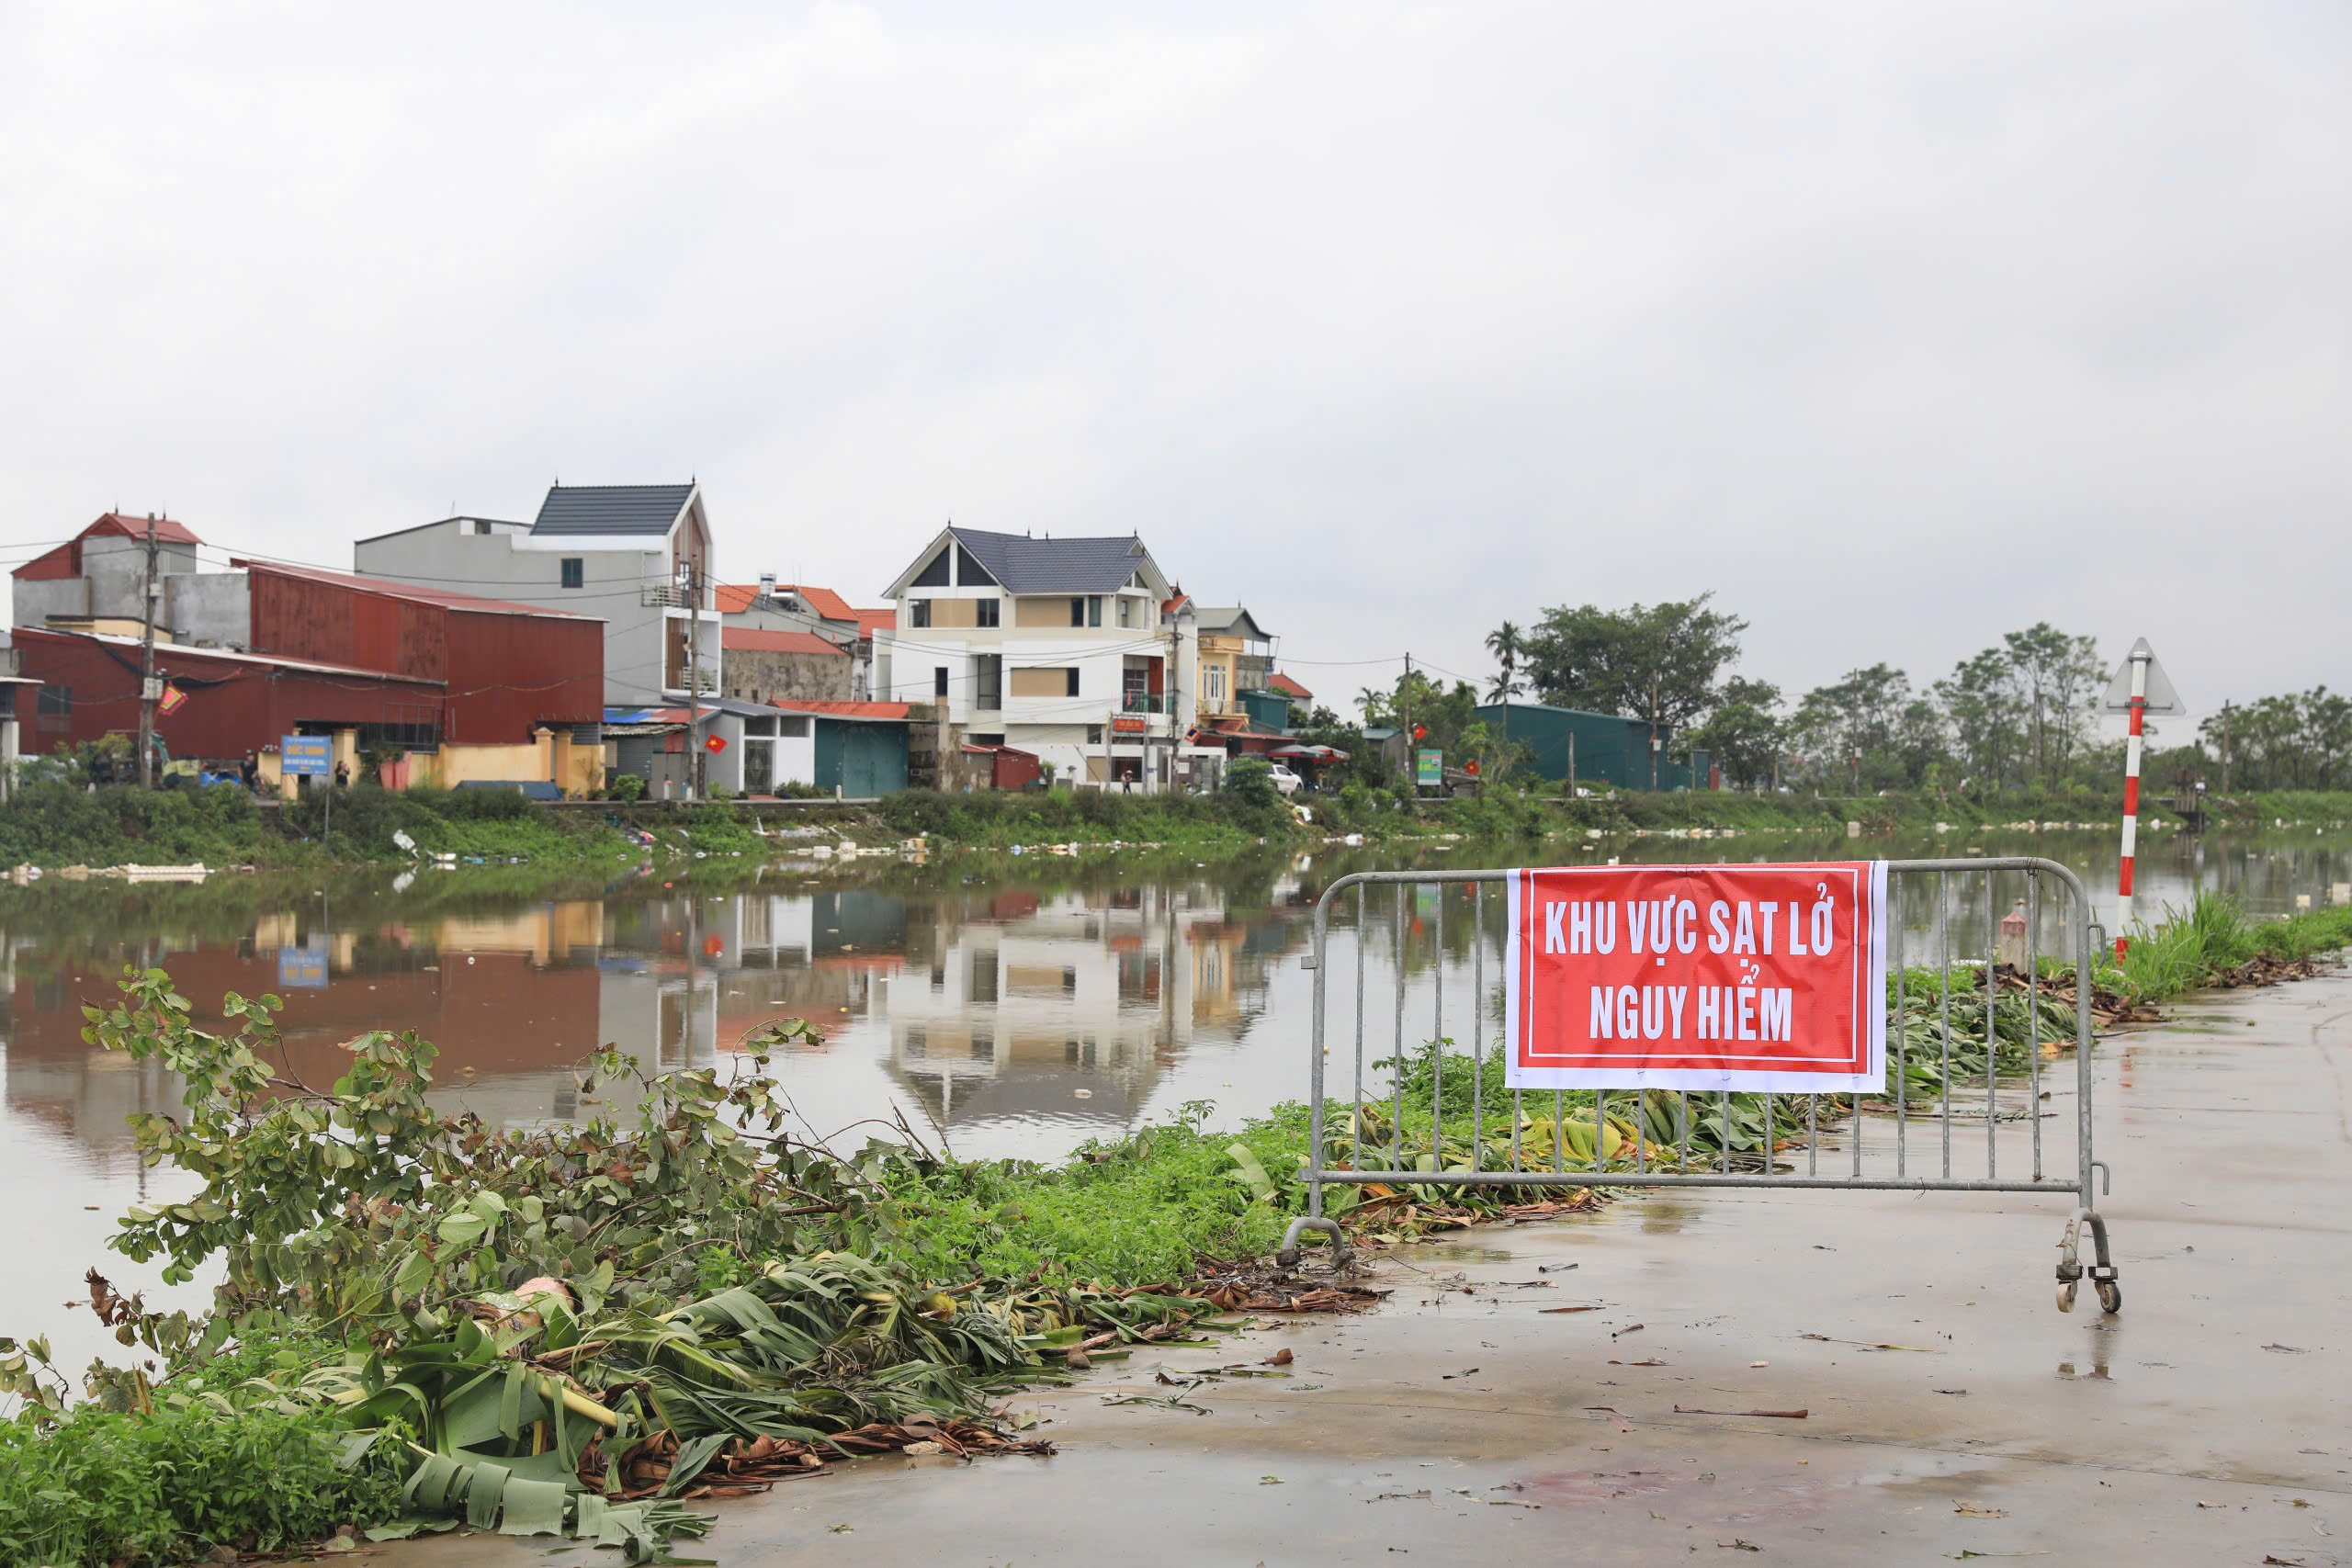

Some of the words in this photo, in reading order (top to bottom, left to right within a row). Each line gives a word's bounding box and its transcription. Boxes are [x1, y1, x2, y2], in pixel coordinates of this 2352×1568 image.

[1545, 901, 1616, 954] KHU
[1627, 895, 1697, 966] VỰC
[1708, 899, 1778, 967] SẠT
[1789, 882, 1835, 956] LỞ
[1589, 986, 1688, 1041] NGUY
[1698, 964, 1792, 1042] HIỂM
